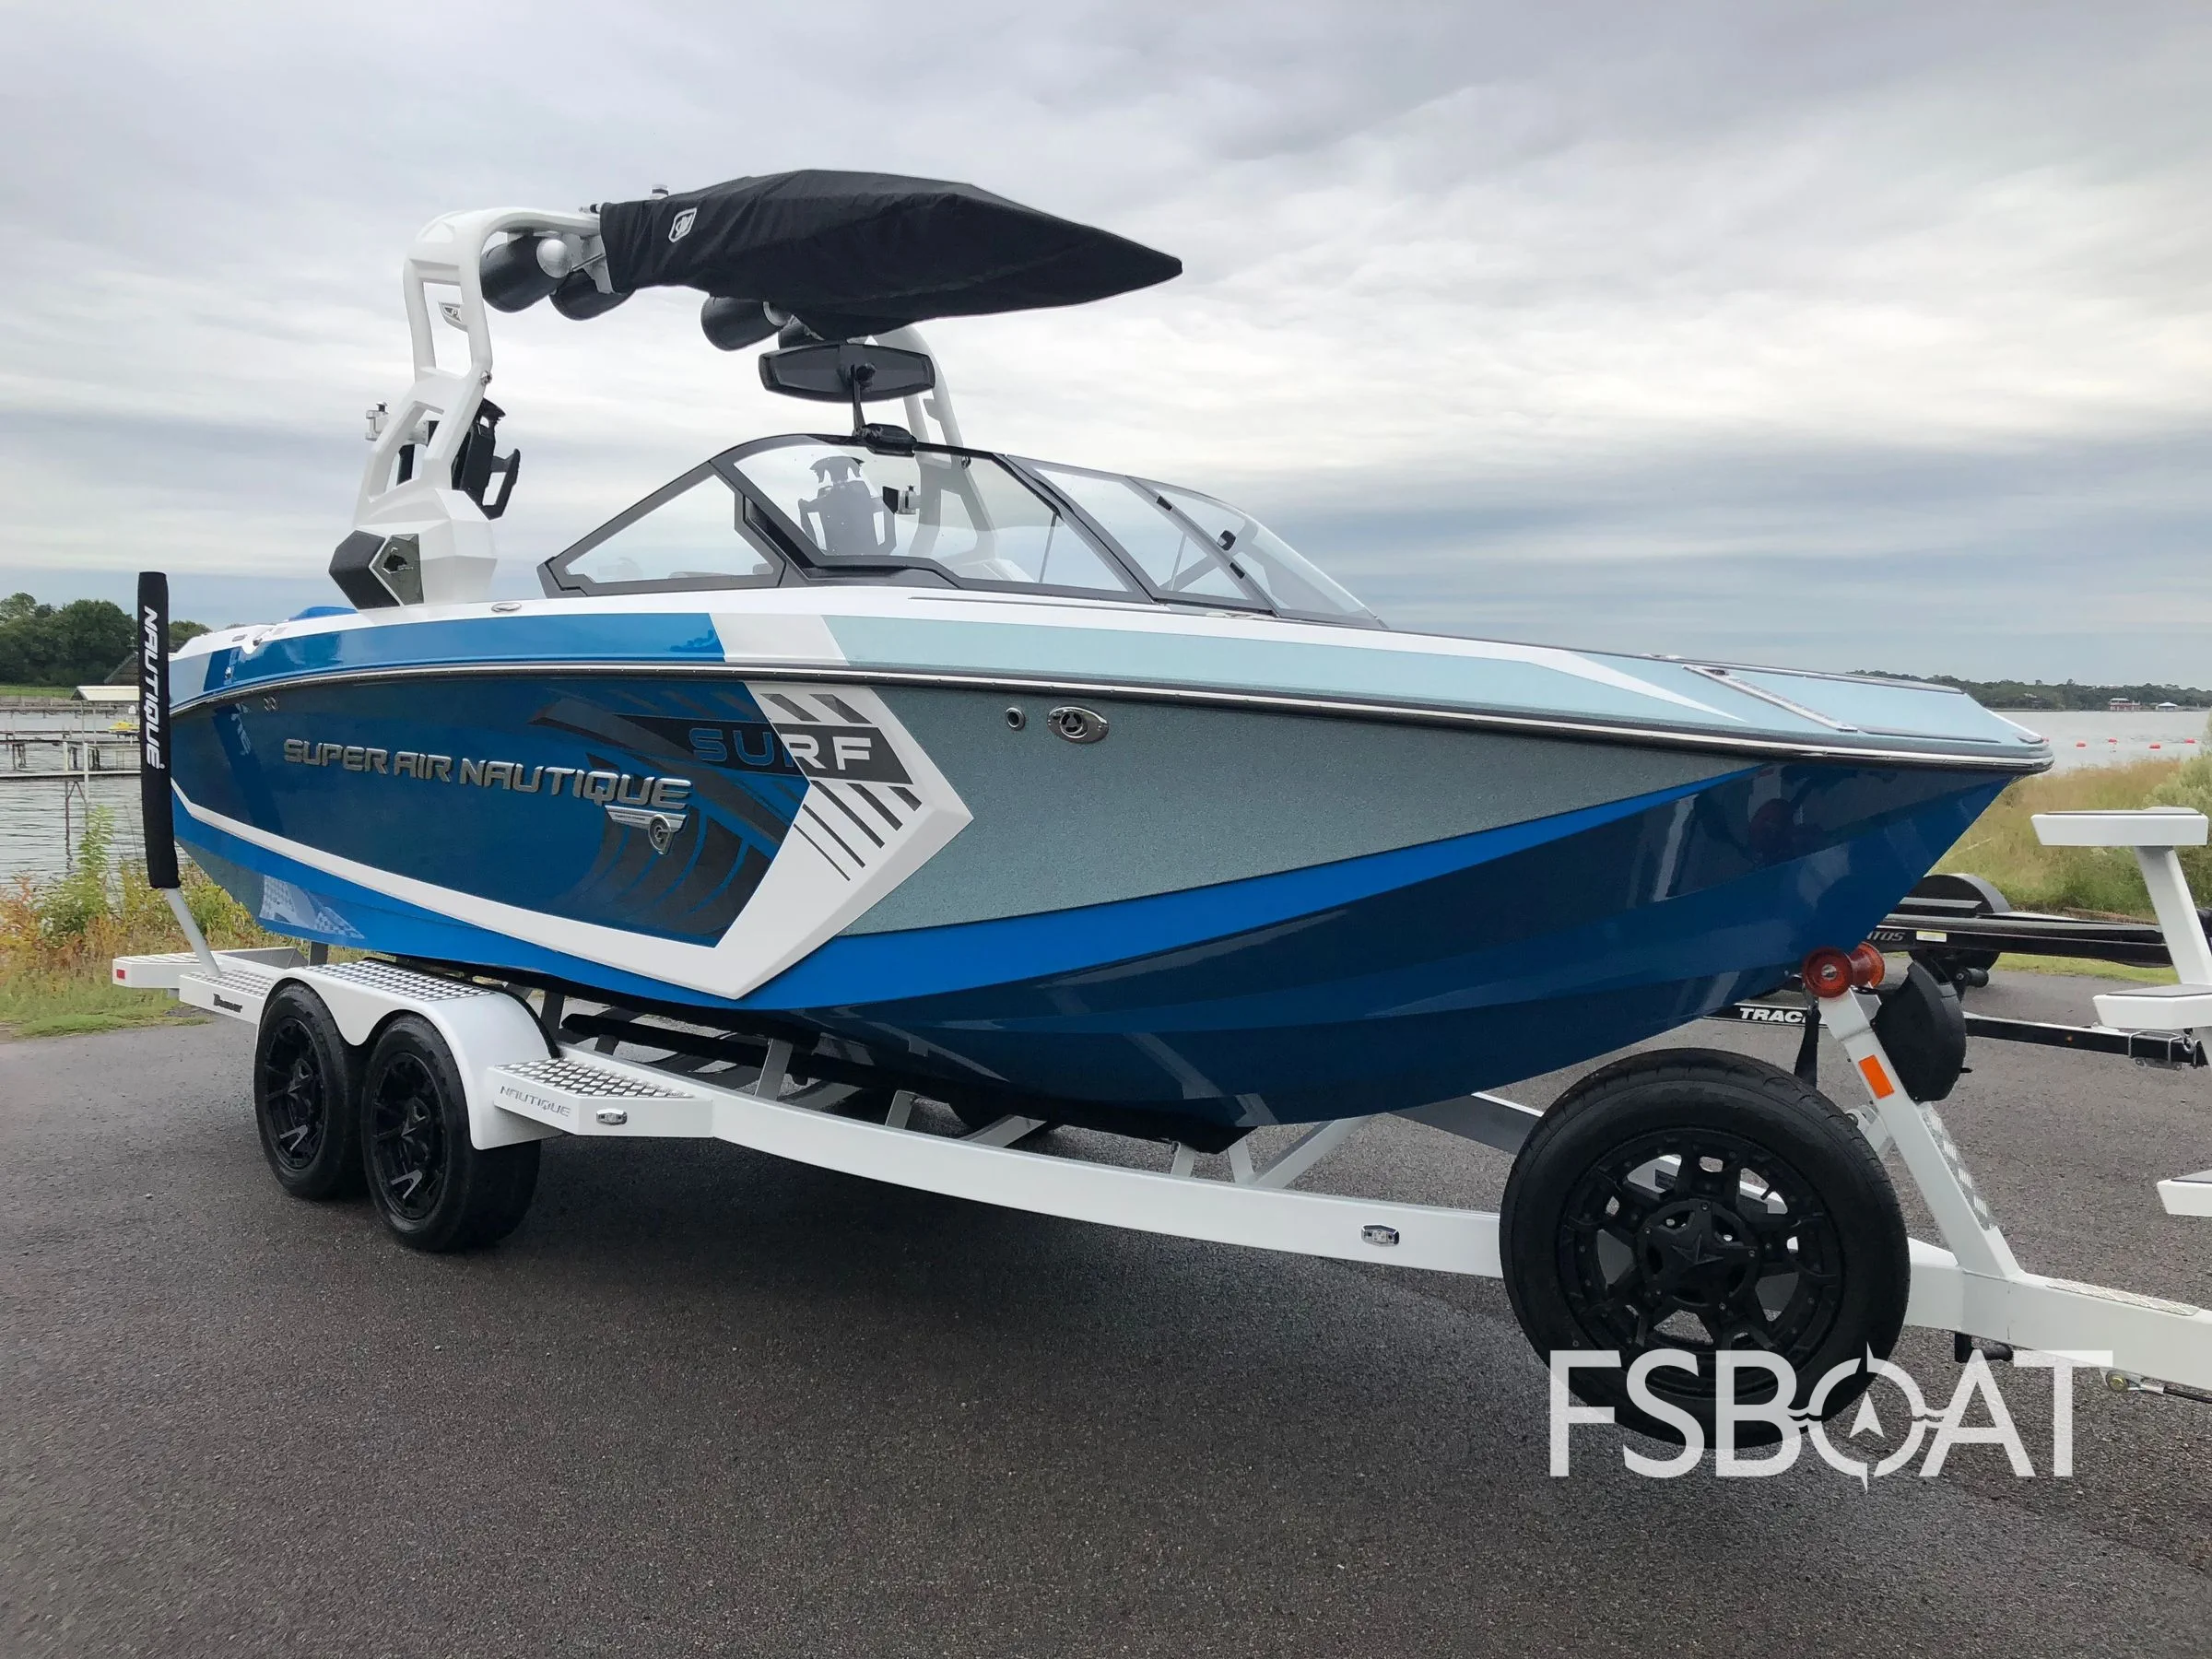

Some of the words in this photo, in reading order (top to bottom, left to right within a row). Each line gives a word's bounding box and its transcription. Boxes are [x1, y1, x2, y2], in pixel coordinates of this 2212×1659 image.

[144, 606, 162, 769] NAUTIQUE
[688, 726, 872, 771] SURF
[283, 738, 389, 775] SUPER
[394, 750, 453, 782] AIR
[460, 758, 693, 809] NAUTIQUE
[1739, 1007, 1806, 1023] TRAC
[500, 1086, 571, 1117] NAUTIQUE
